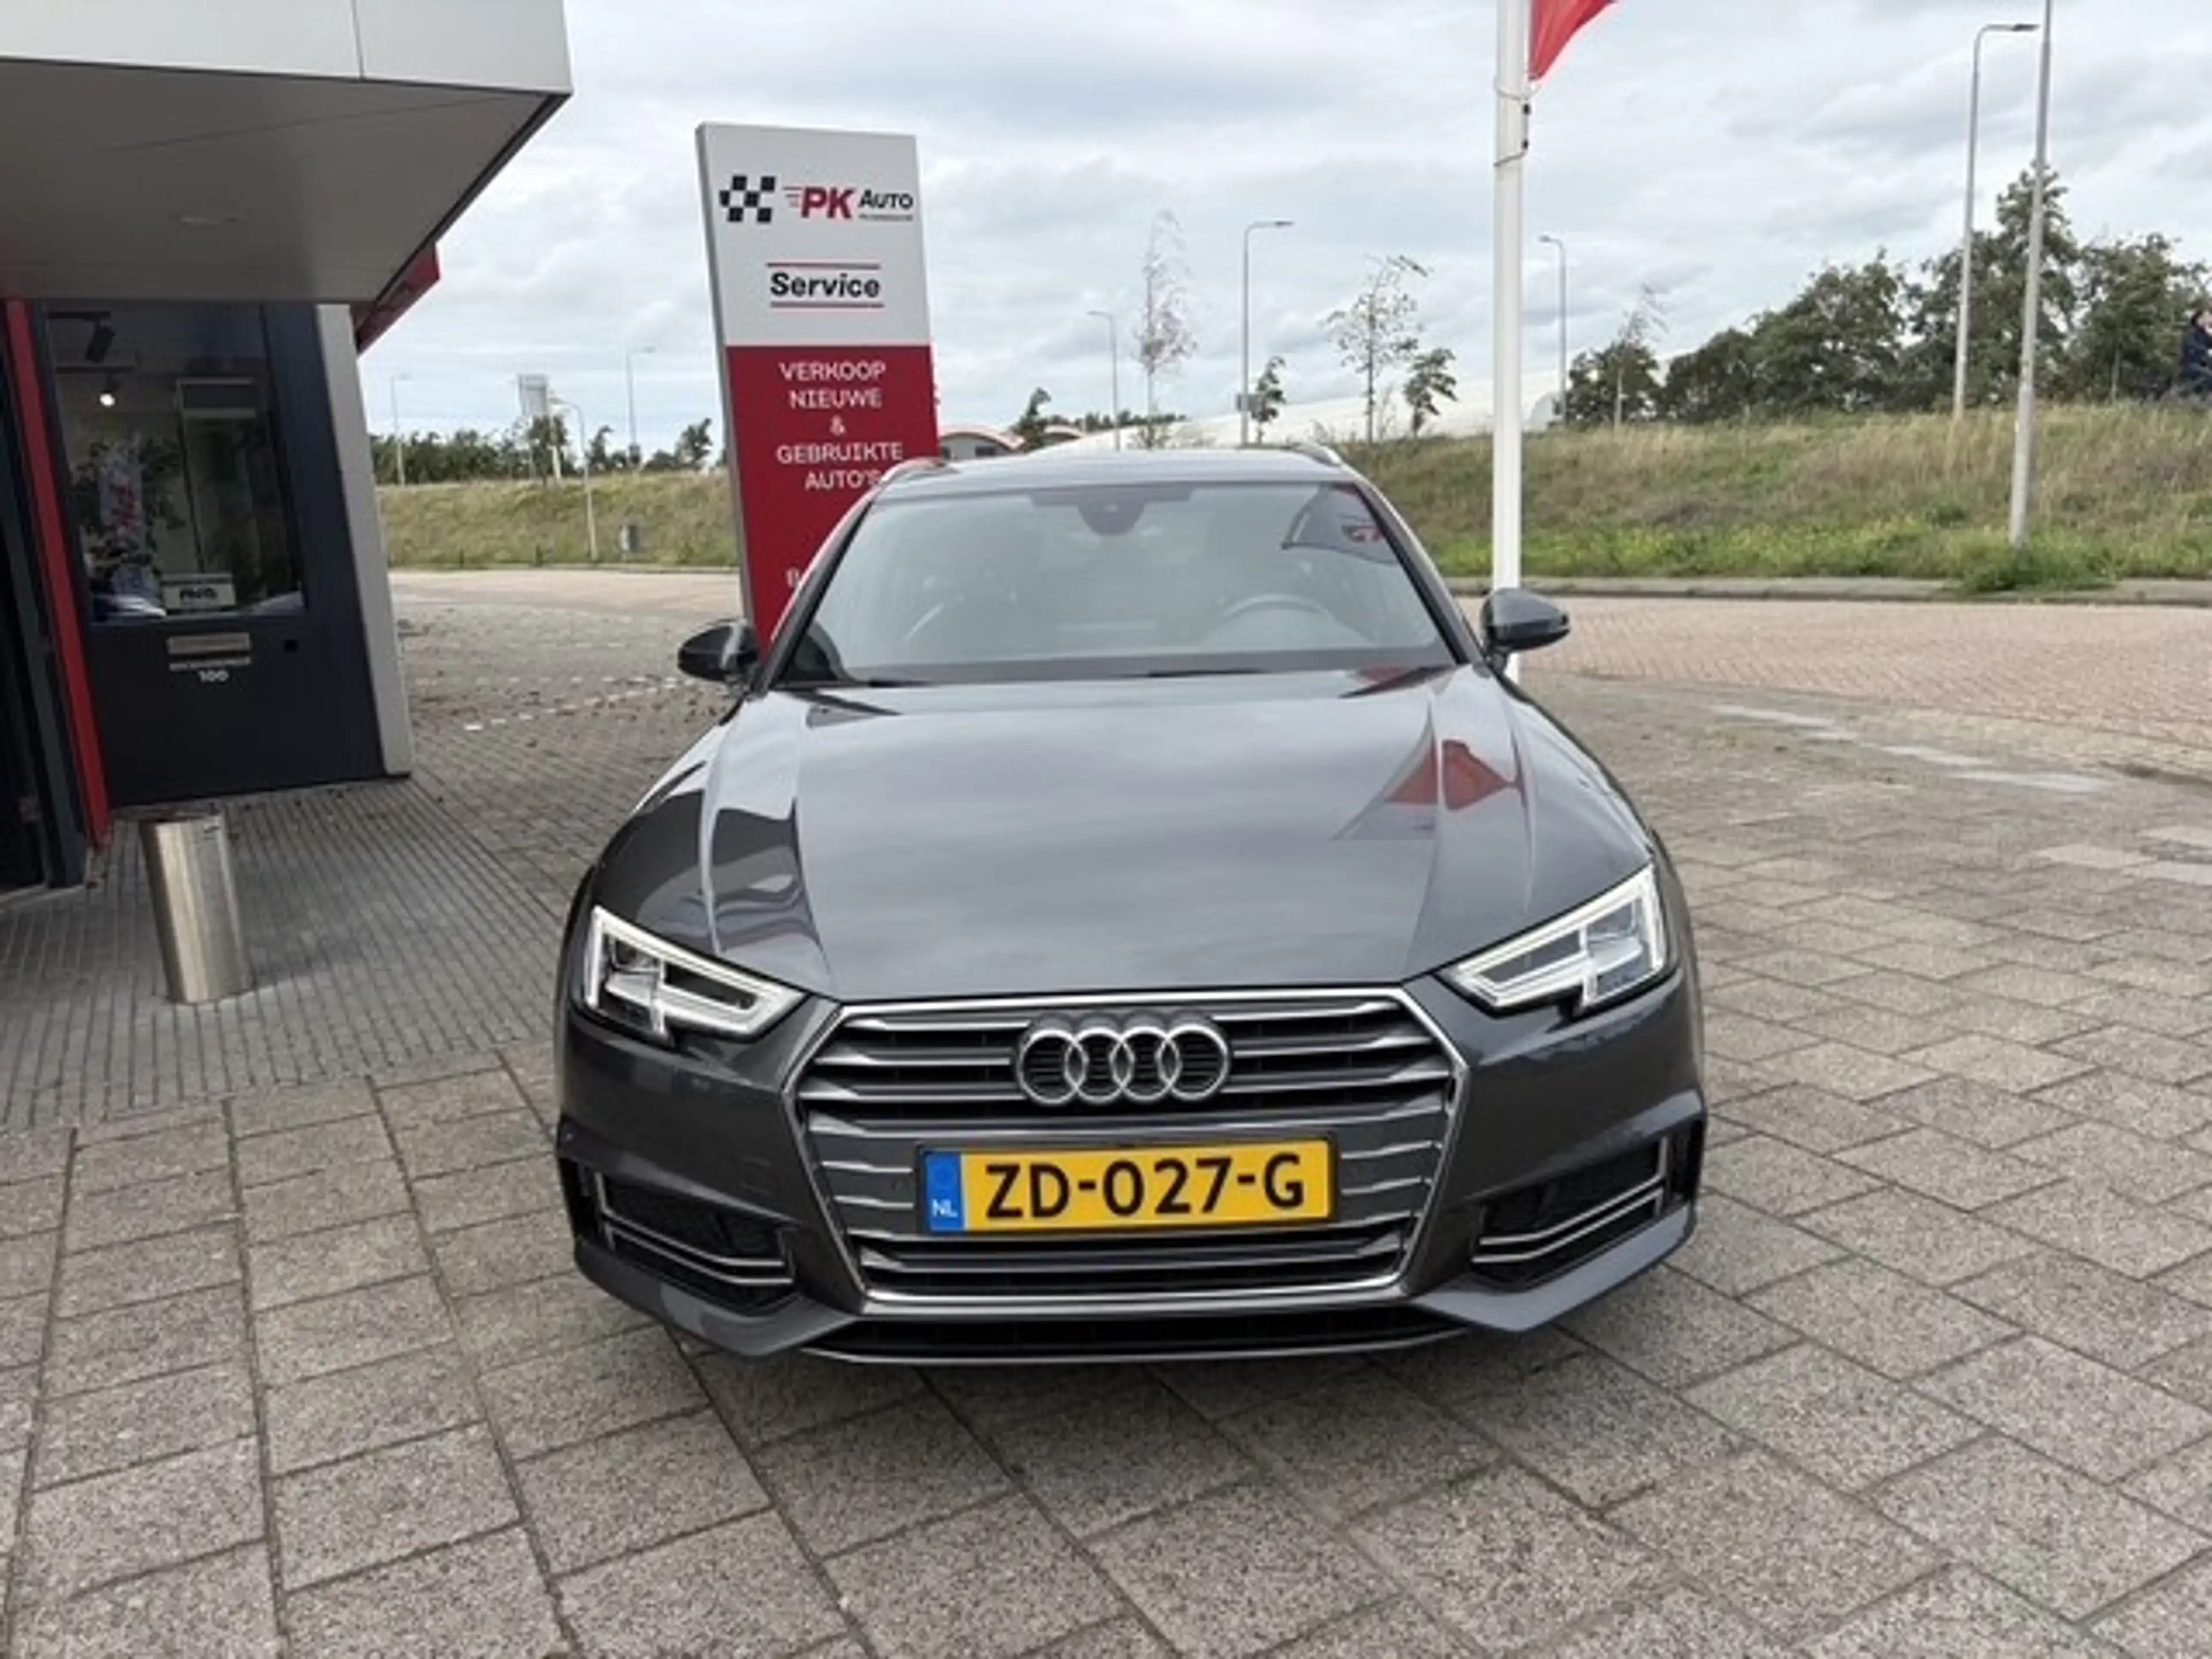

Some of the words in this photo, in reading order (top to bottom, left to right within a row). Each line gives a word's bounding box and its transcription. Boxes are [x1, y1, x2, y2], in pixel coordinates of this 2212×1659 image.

[801, 187, 855, 219] PK
[770, 272, 880, 297] Service
[778, 361, 886, 381] VERKOOP
[789, 388, 883, 409] NIEUWE
[830, 415, 846, 435] &
[776, 442, 904, 464] GEBRUIKTE
[931, 1199, 958, 1218] NL
[985, 1153, 1305, 1219] ZD-027-G
